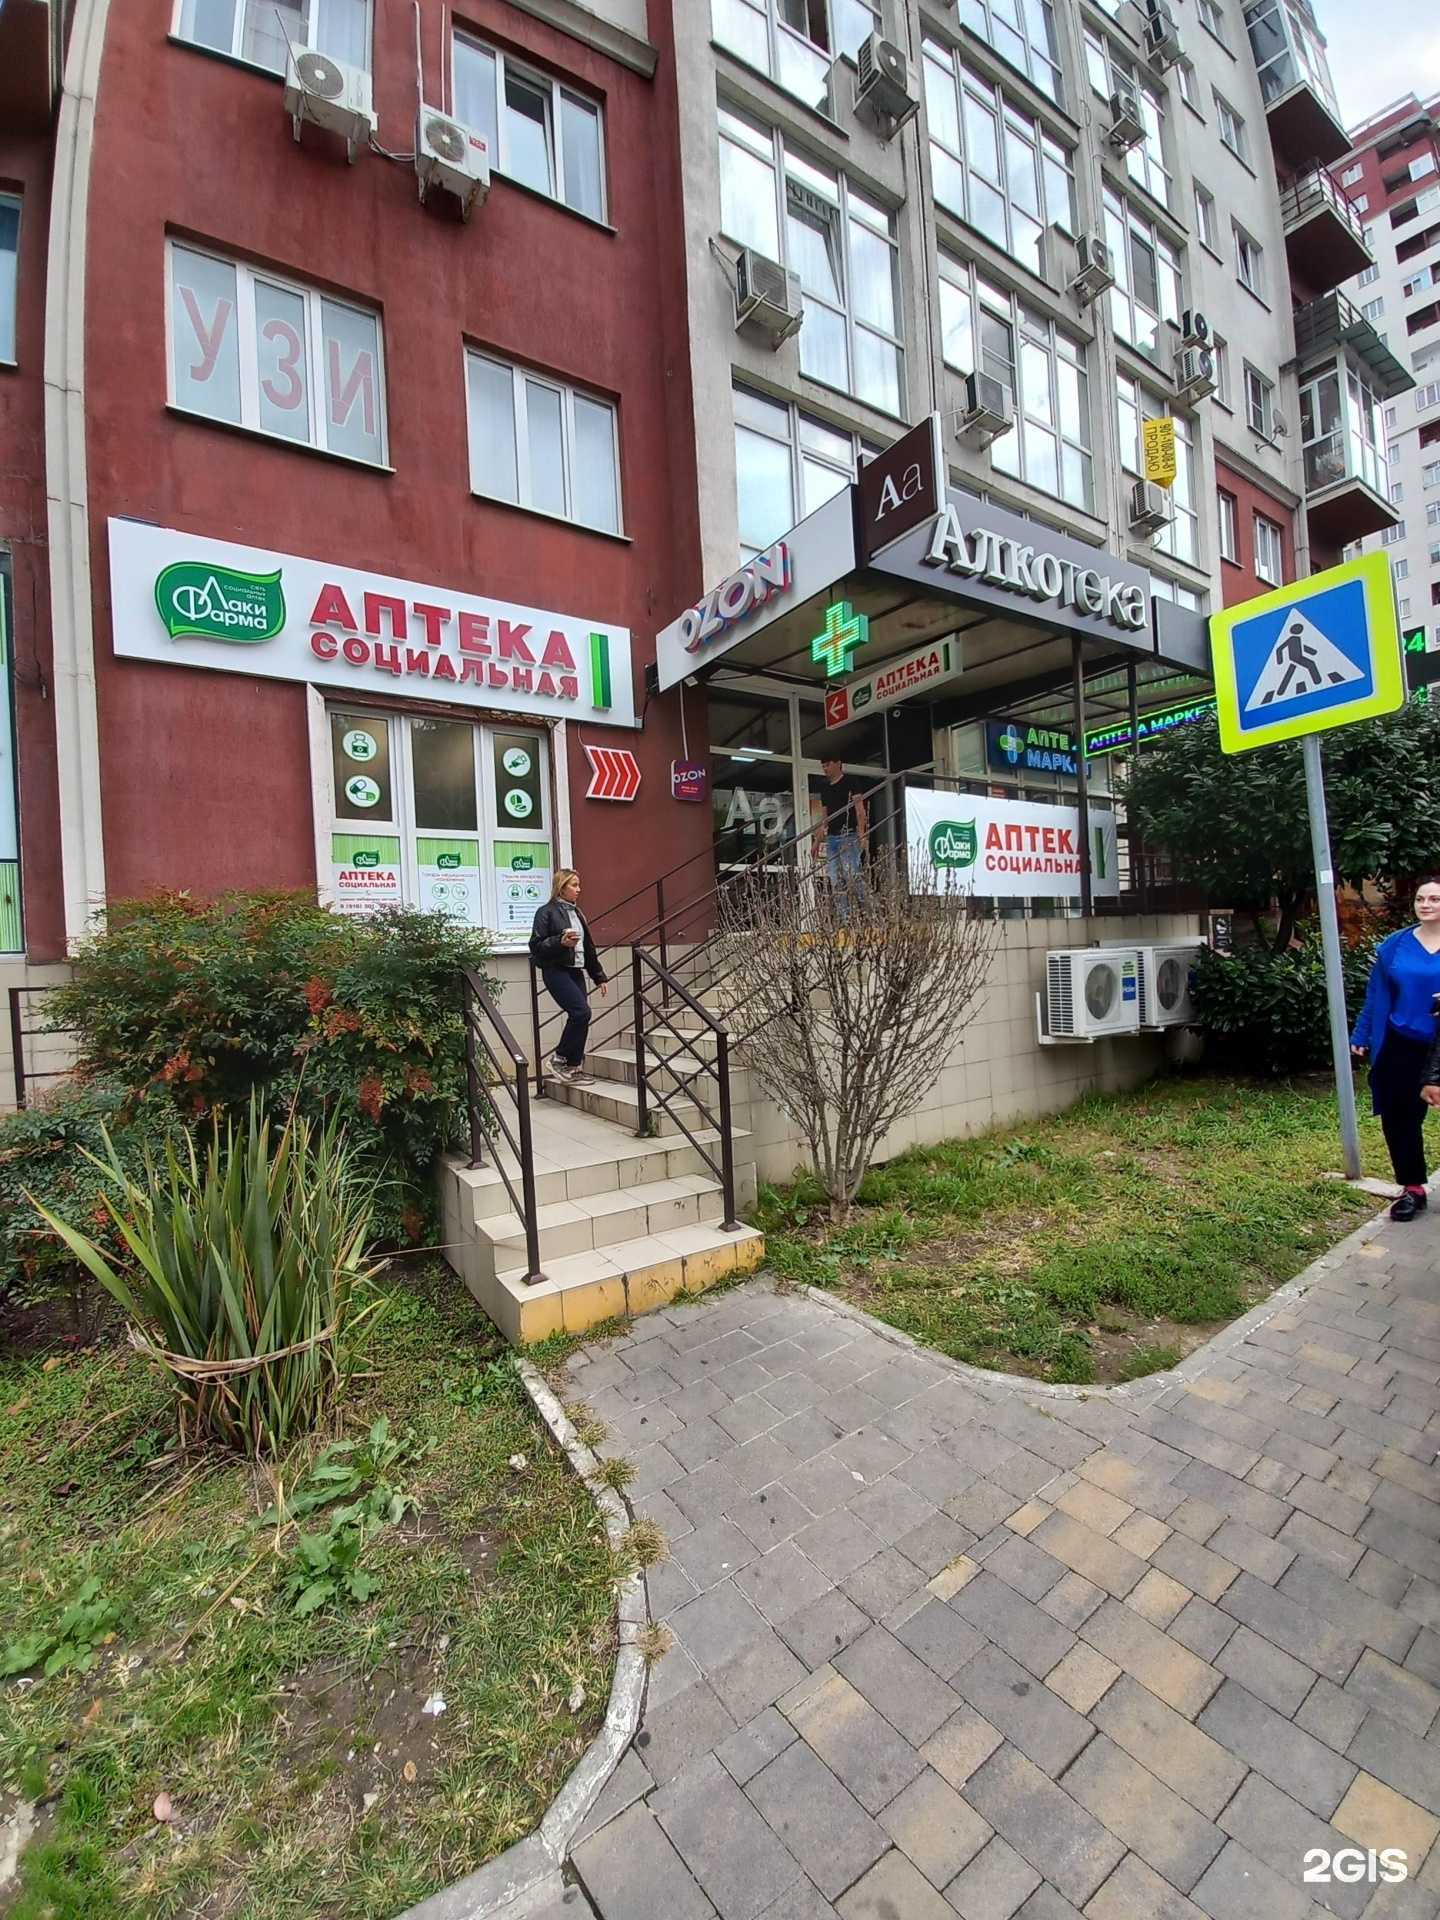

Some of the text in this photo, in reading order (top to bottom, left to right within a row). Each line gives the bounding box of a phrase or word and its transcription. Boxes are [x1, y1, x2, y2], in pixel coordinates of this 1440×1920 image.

[177, 284, 376, 437] УЗИ
[1145, 426, 1161, 473] ПРОДАЮ
[923, 503, 1150, 632] Алкотека
[172, 585, 268, 631] Фарма
[198, 575, 267, 617] Лаки
[679, 541, 793, 656] OZON
[309, 583, 578, 671] АПТЕКА
[310, 631, 580, 699] СОЦИАЛЬНАЯ
[875, 651, 940, 691] АПТЕКА
[875, 666, 941, 700] СОЦИАЛЬНАЯ
[1027, 727, 1073, 751] АПТЕ
[672, 767, 706, 784] OZON
[1027, 748, 1090, 776] МАРК
[985, 822, 1081, 855] АПТЕК
[338, 870, 397, 881] АПТЕКА
[985, 854, 1083, 874] СОЦИАЛЬНА
[338, 881, 397, 889] СОЦИАЛЬНАЯ
